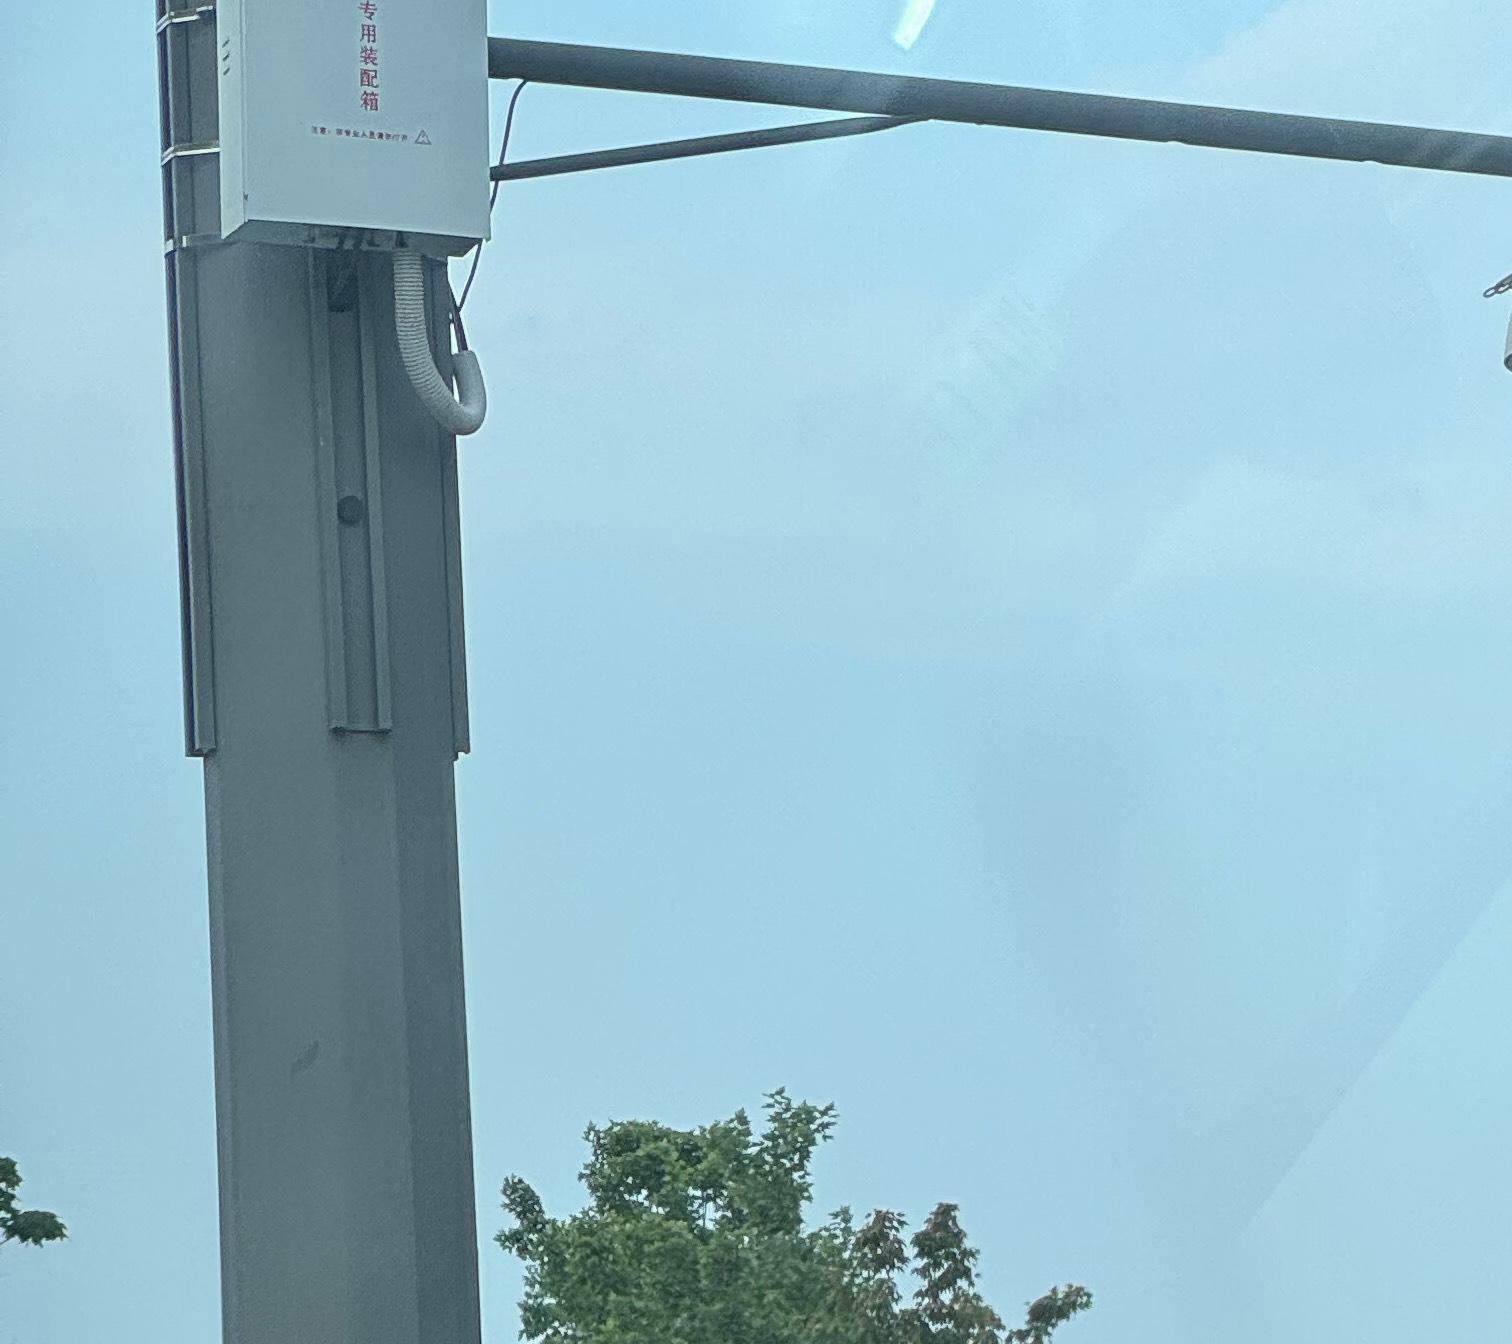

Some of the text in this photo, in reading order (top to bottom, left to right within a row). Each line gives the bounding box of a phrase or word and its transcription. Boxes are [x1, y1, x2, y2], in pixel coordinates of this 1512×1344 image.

[358, 0, 379, 112] 专用装配箱
